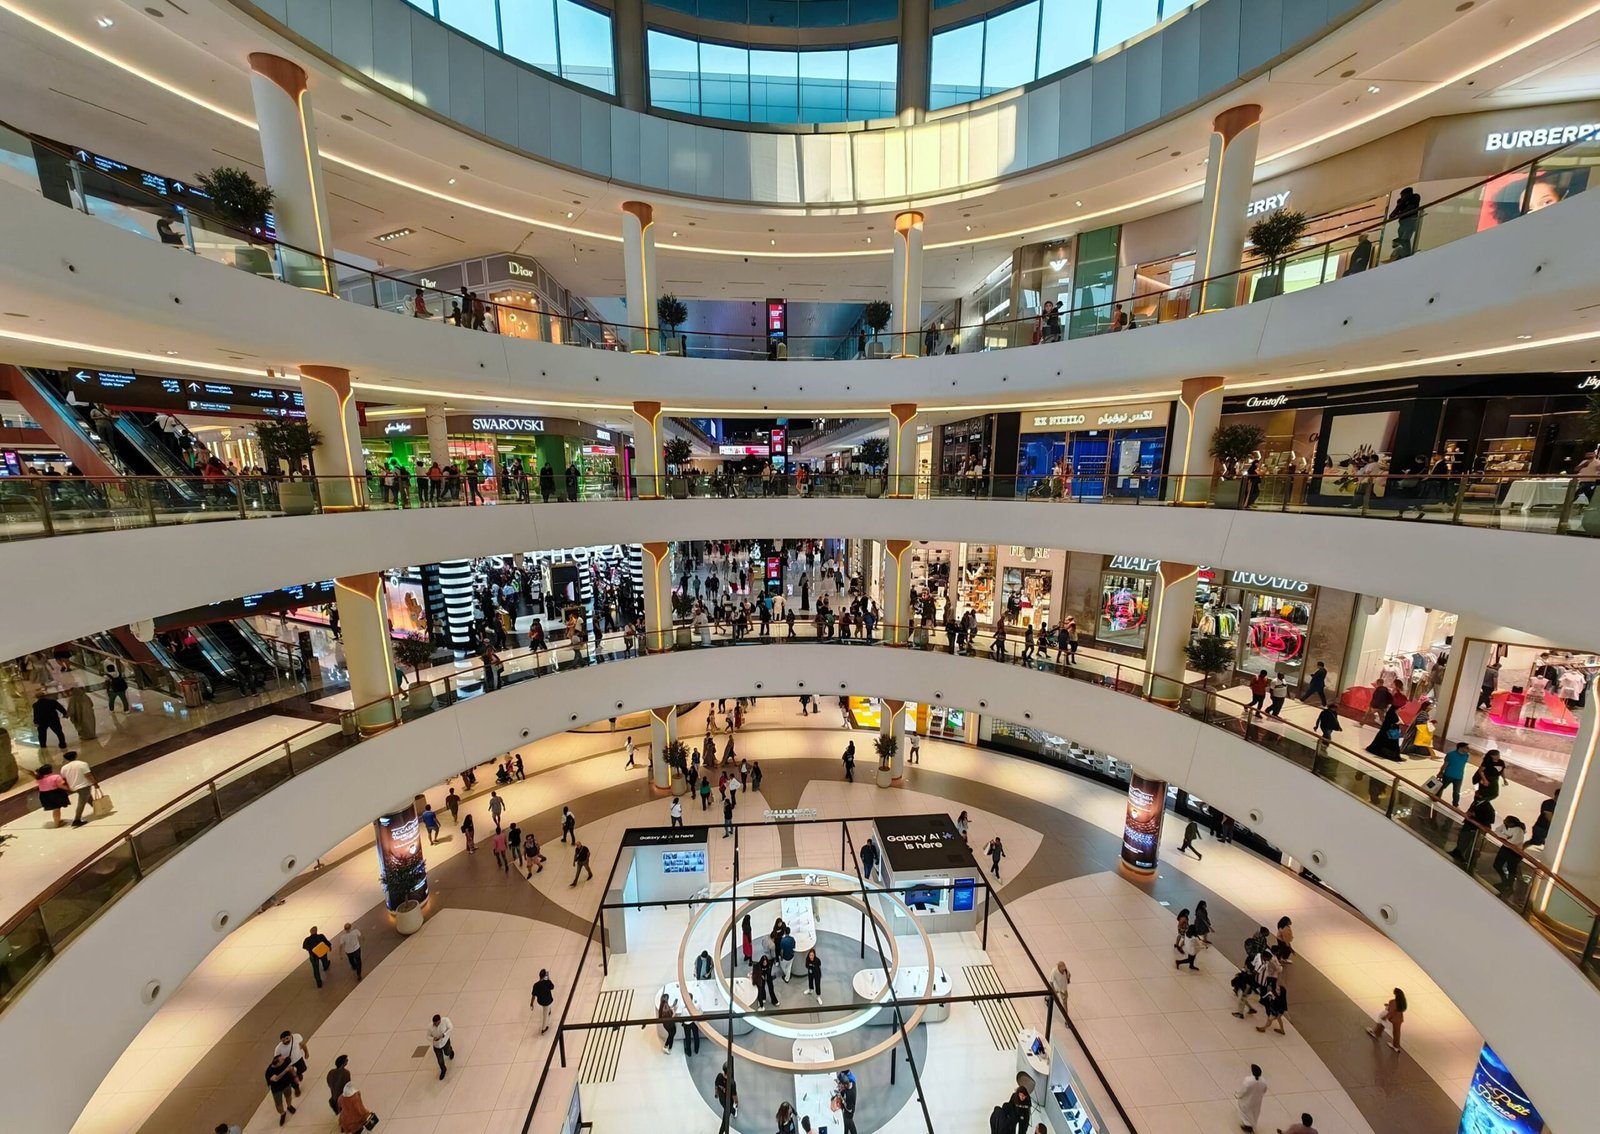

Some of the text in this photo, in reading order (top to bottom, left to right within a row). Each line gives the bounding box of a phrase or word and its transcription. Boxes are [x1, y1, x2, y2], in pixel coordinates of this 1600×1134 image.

[1485, 123, 1600, 151] BURBERR
[508, 261, 534, 277] Dior
[421, 278, 437, 290] Dior
[190, 401, 198, 409] P
[1246, 394, 1289, 408] Christofle
[472, 418, 545, 432] SWAROVSKI
[1049, 414, 1085, 425] NIHILO
[490, 543, 624, 569] SPHORA
[887, 834, 926, 843] Galaxy
[903, 841, 943, 850] is here
[1475, 1083, 1517, 1120] Prince
[1491, 1087, 1531, 1116] Petit
